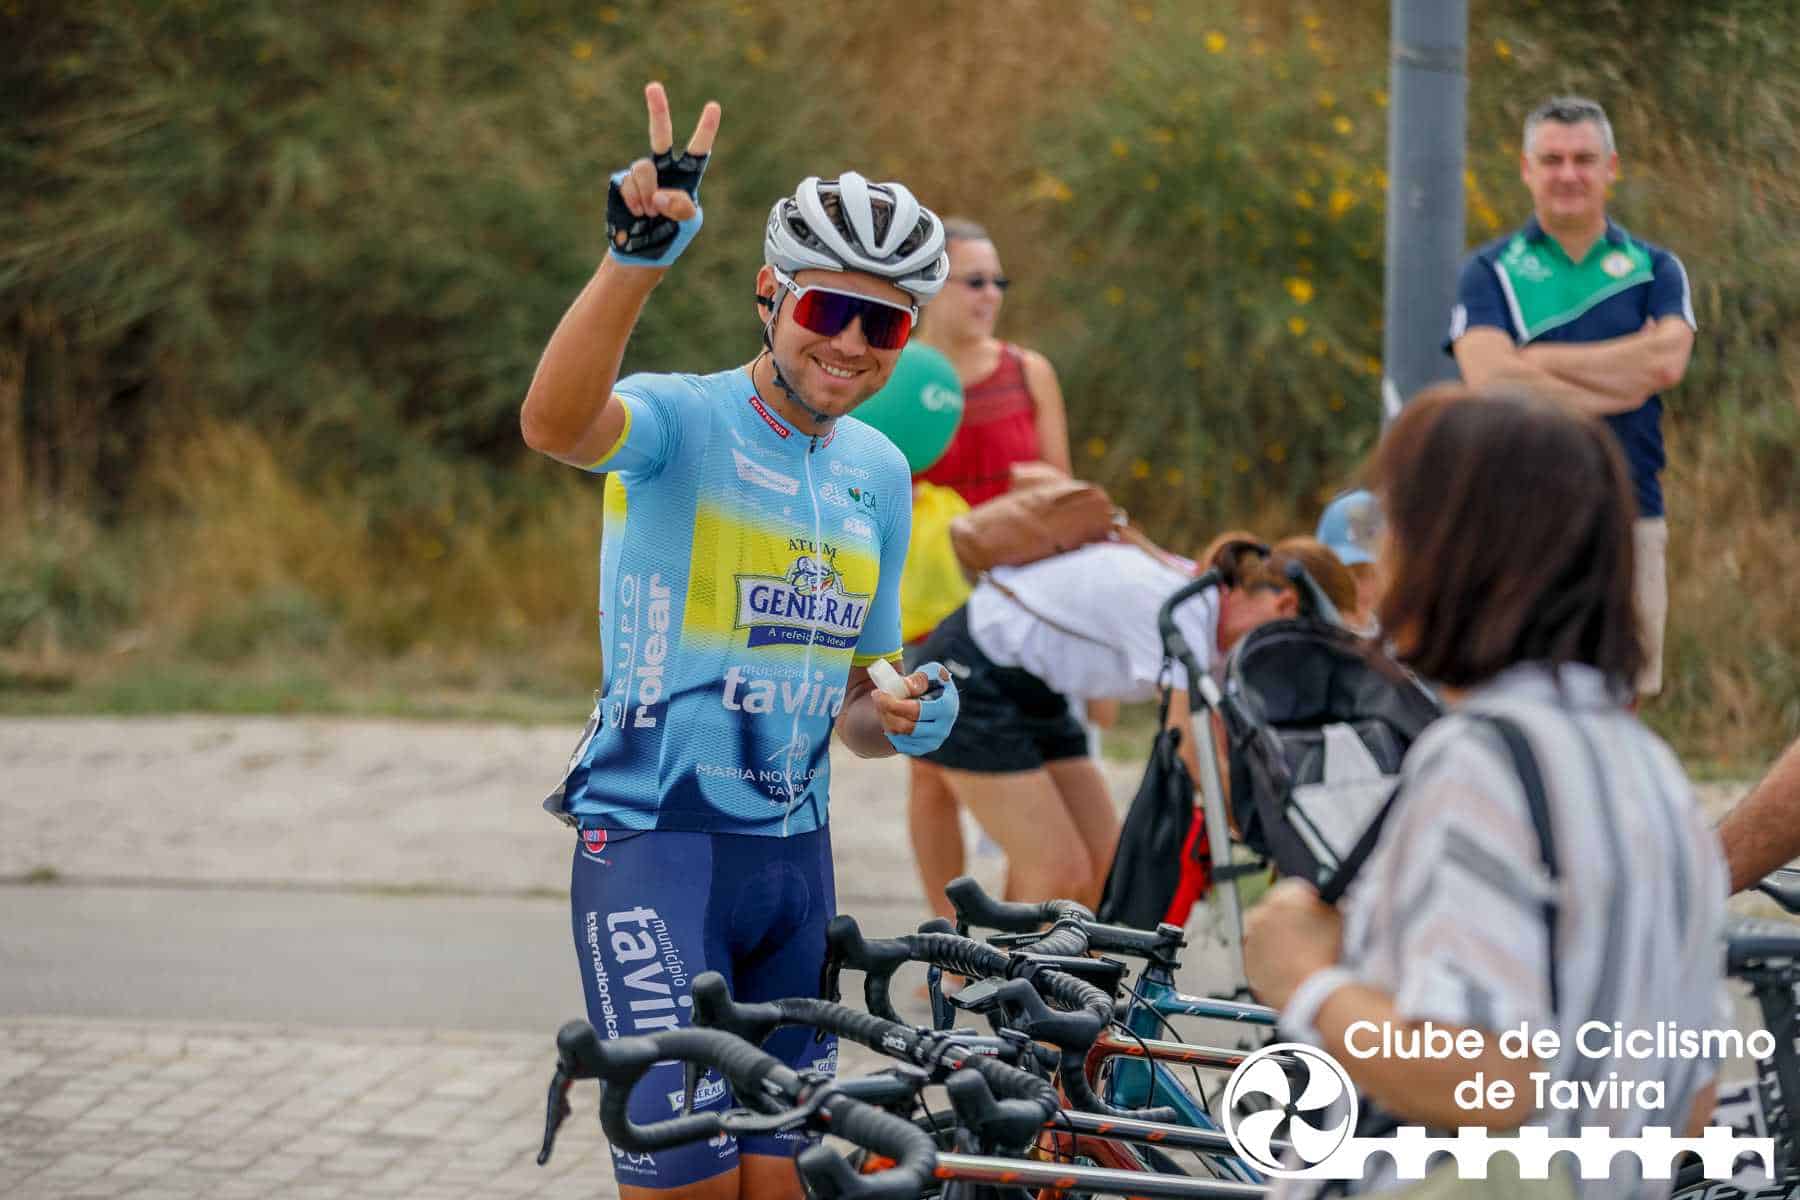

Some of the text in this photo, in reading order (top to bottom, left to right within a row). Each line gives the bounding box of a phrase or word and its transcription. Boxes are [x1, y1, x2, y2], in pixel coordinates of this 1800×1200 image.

[609, 574, 635, 728] GRUPO
[634, 572, 671, 728] rolear
[749, 585, 863, 630] GENERAL
[696, 763, 756, 781] MARIA
[606, 906, 693, 1032] tavir
[653, 919, 688, 987] município
